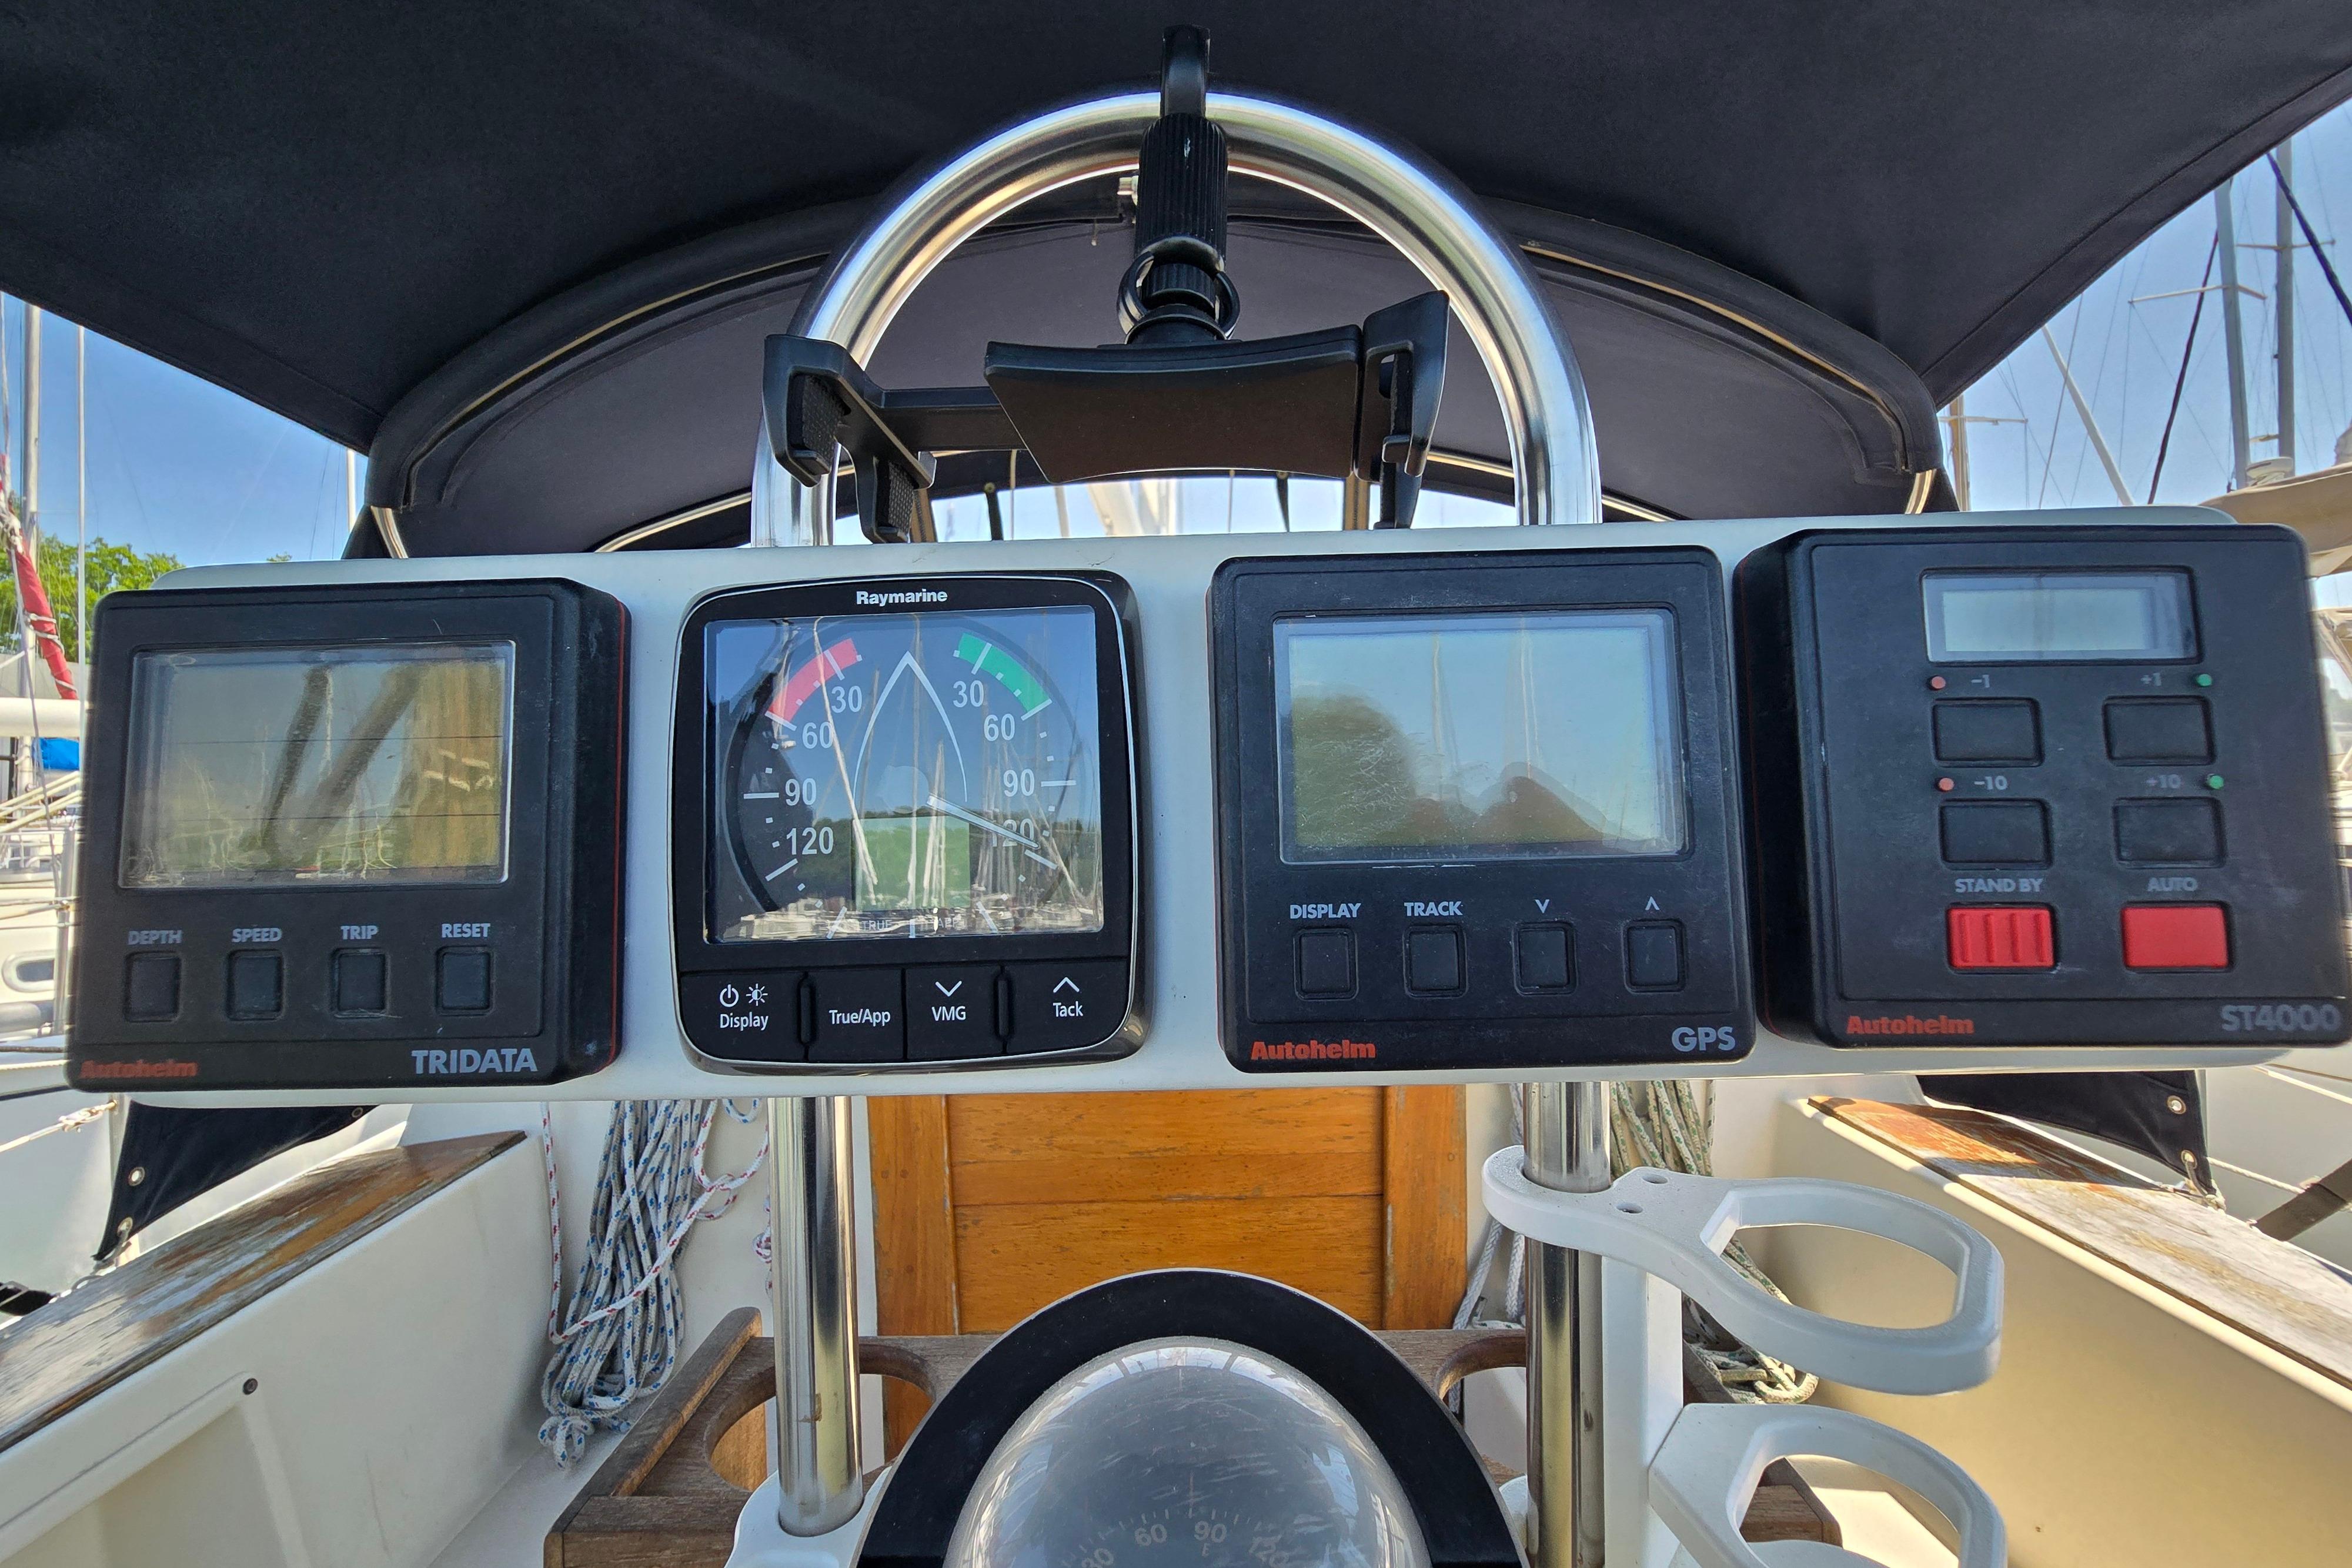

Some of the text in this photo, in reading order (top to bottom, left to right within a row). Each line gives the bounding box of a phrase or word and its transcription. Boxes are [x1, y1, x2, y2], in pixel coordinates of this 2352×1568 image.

[856, 589, 948, 607] Raymarine
[831, 686, 863, 713] 30
[953, 680, 984, 708] 30
[801, 721, 833, 750] 60
[983, 713, 1015, 741] 60
[785, 778, 817, 807] 90
[1003, 769, 1035, 797] 90
[786, 827, 834, 855] 120
[2147, 877, 2198, 892] AUTO
[1289, 902, 1362, 920] DISPLAY
[1404, 901, 1463, 917] TRACK
[128, 929, 183, 945] DEPTH
[232, 927, 283, 943] SPEED
[340, 925, 379, 940] TRIP
[442, 922, 491, 938] RESET
[829, 1009, 891, 1028] True/App
[931, 1006, 967, 1022] VMG
[1053, 1002, 1084, 1018] Tack
[2220, 1004, 2341, 1032] ST4000
[720, 1013, 769, 1031] Display
[1846, 1015, 1975, 1036] Autohelm
[1251, 1039, 1377, 1061] Autohelm
[1672, 1027, 1736, 1053] GPS
[412, 1048, 538, 1075] TRIDATA
[1135, 1523, 1167, 1547] 60
[1194, 1520, 1227, 1544] 90
